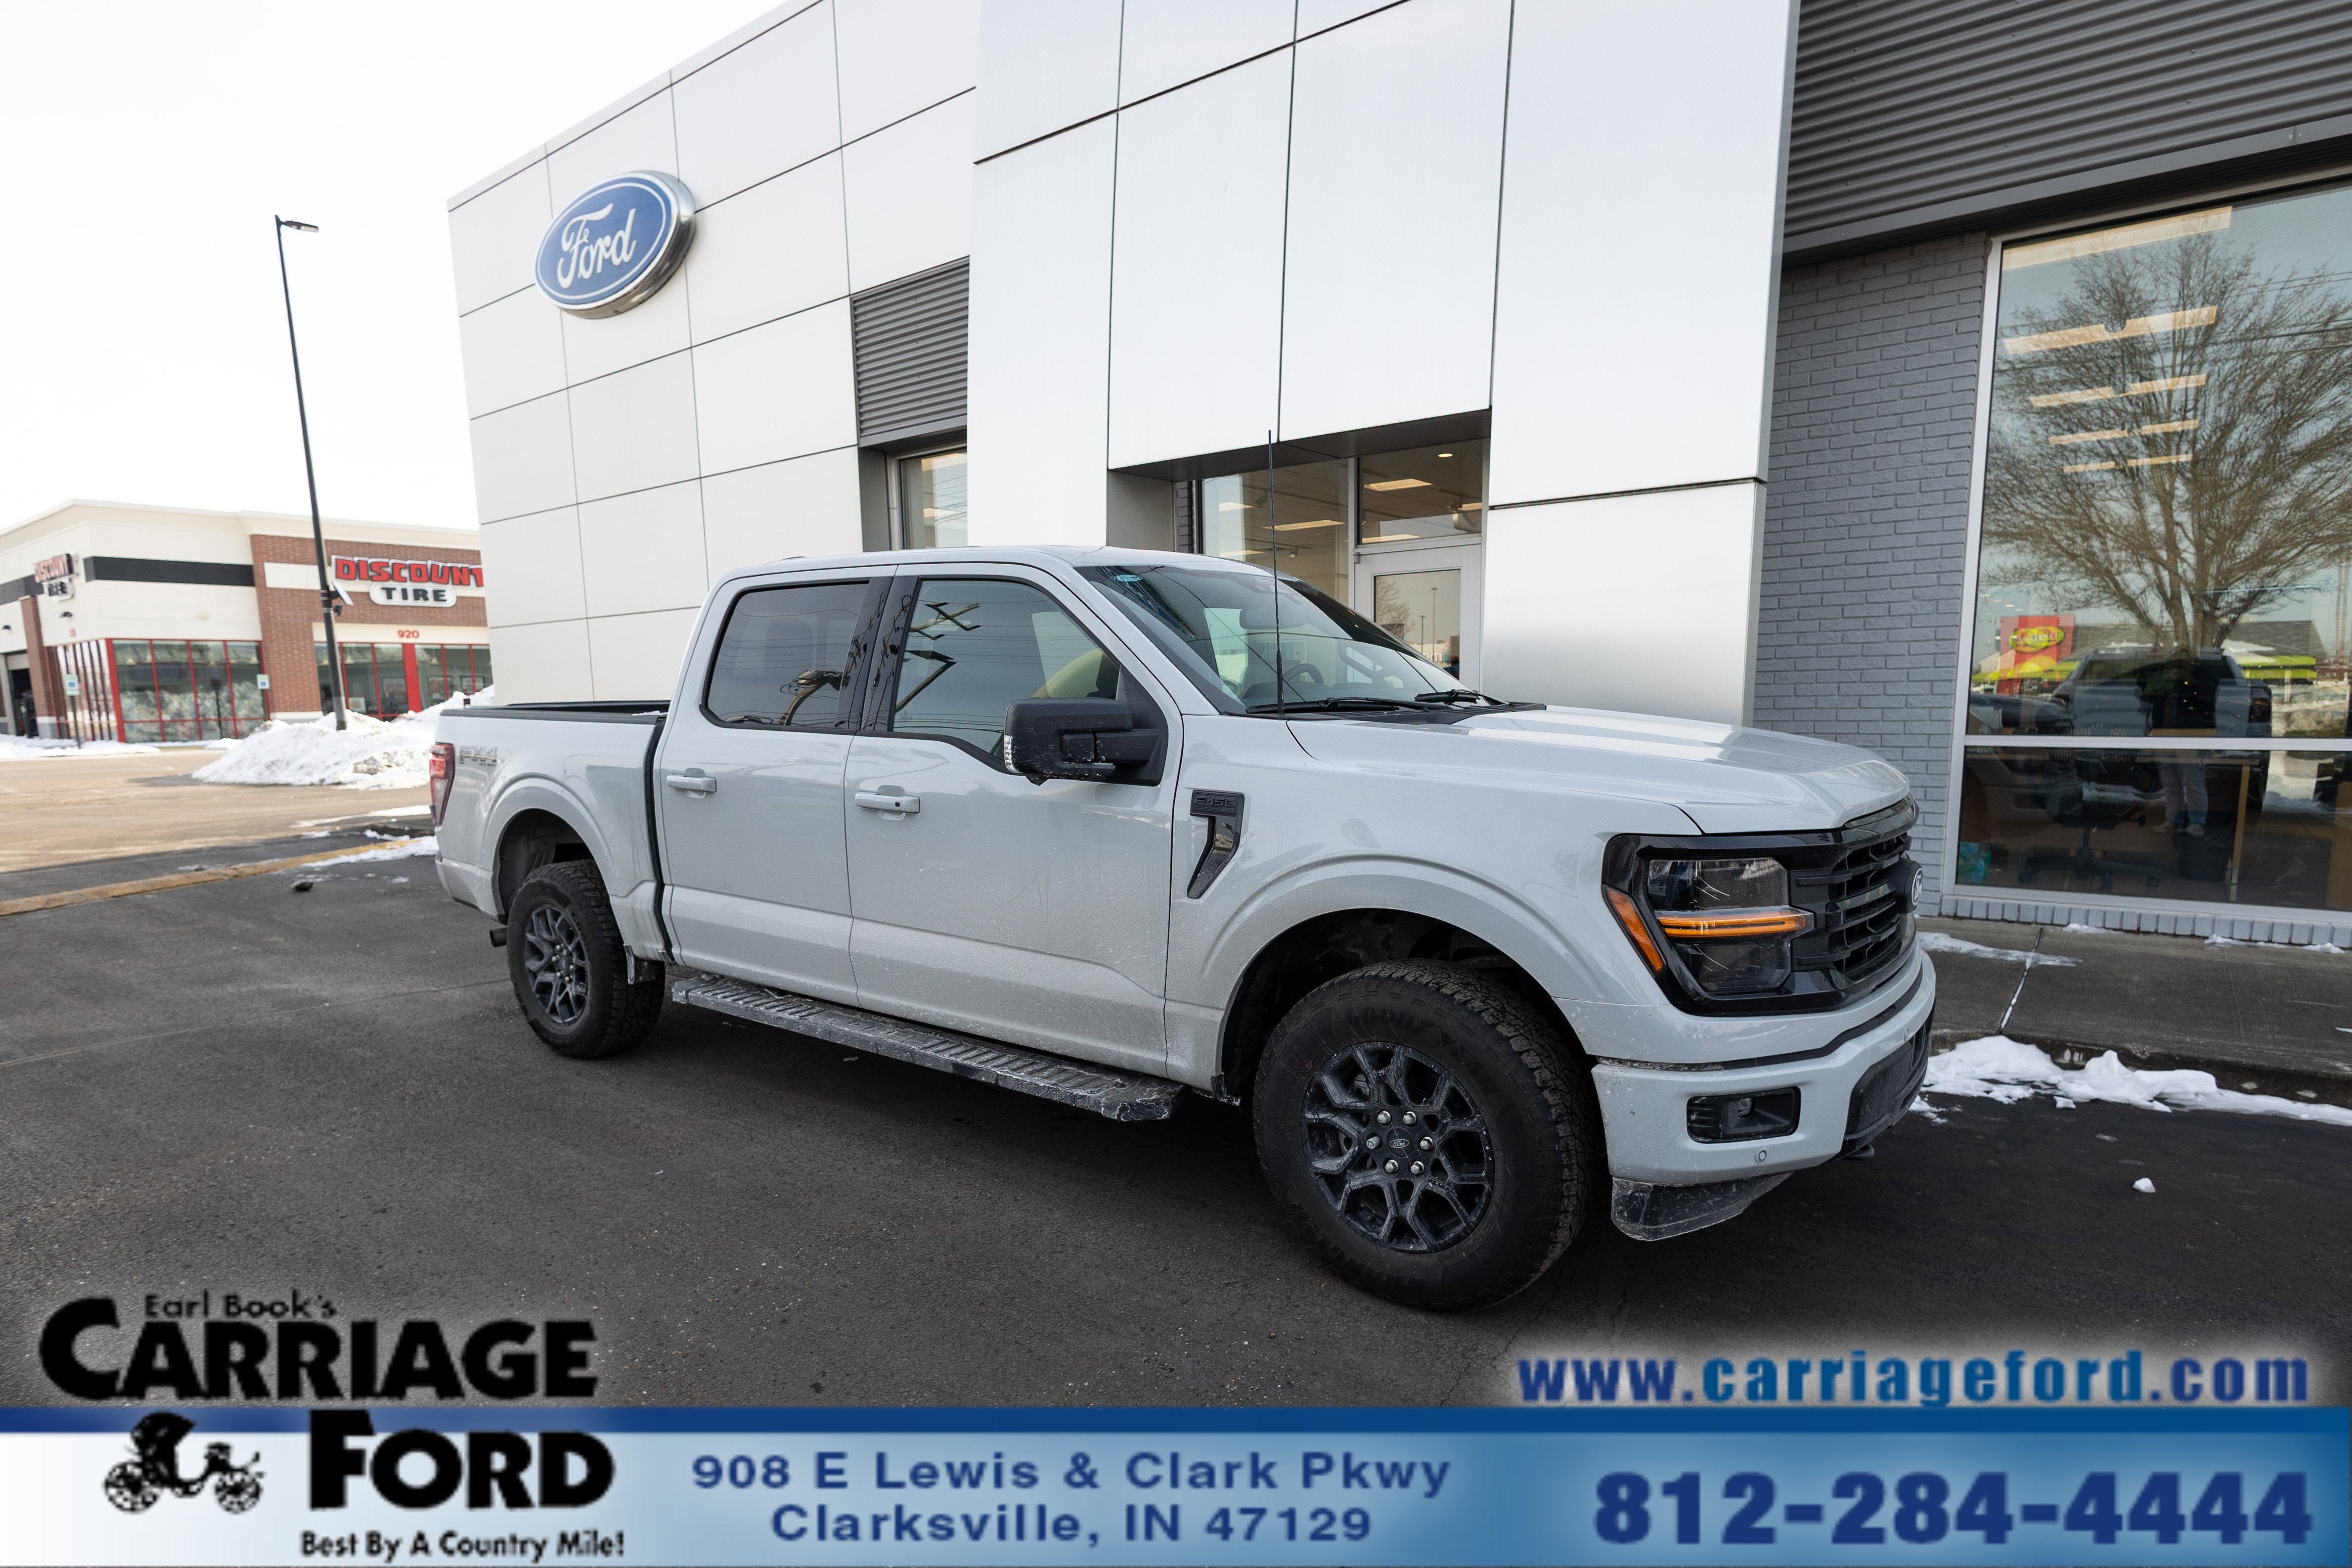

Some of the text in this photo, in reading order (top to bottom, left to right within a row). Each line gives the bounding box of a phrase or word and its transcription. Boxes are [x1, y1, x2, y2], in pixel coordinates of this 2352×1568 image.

[557, 202, 636, 289] Ford
[335, 558, 484, 587] DISCOUNT
[381, 587, 447, 602] TIRE
[397, 629, 420, 638] 920
[459, 745, 497, 764] FX4
[1194, 795, 1237, 807] F-150
